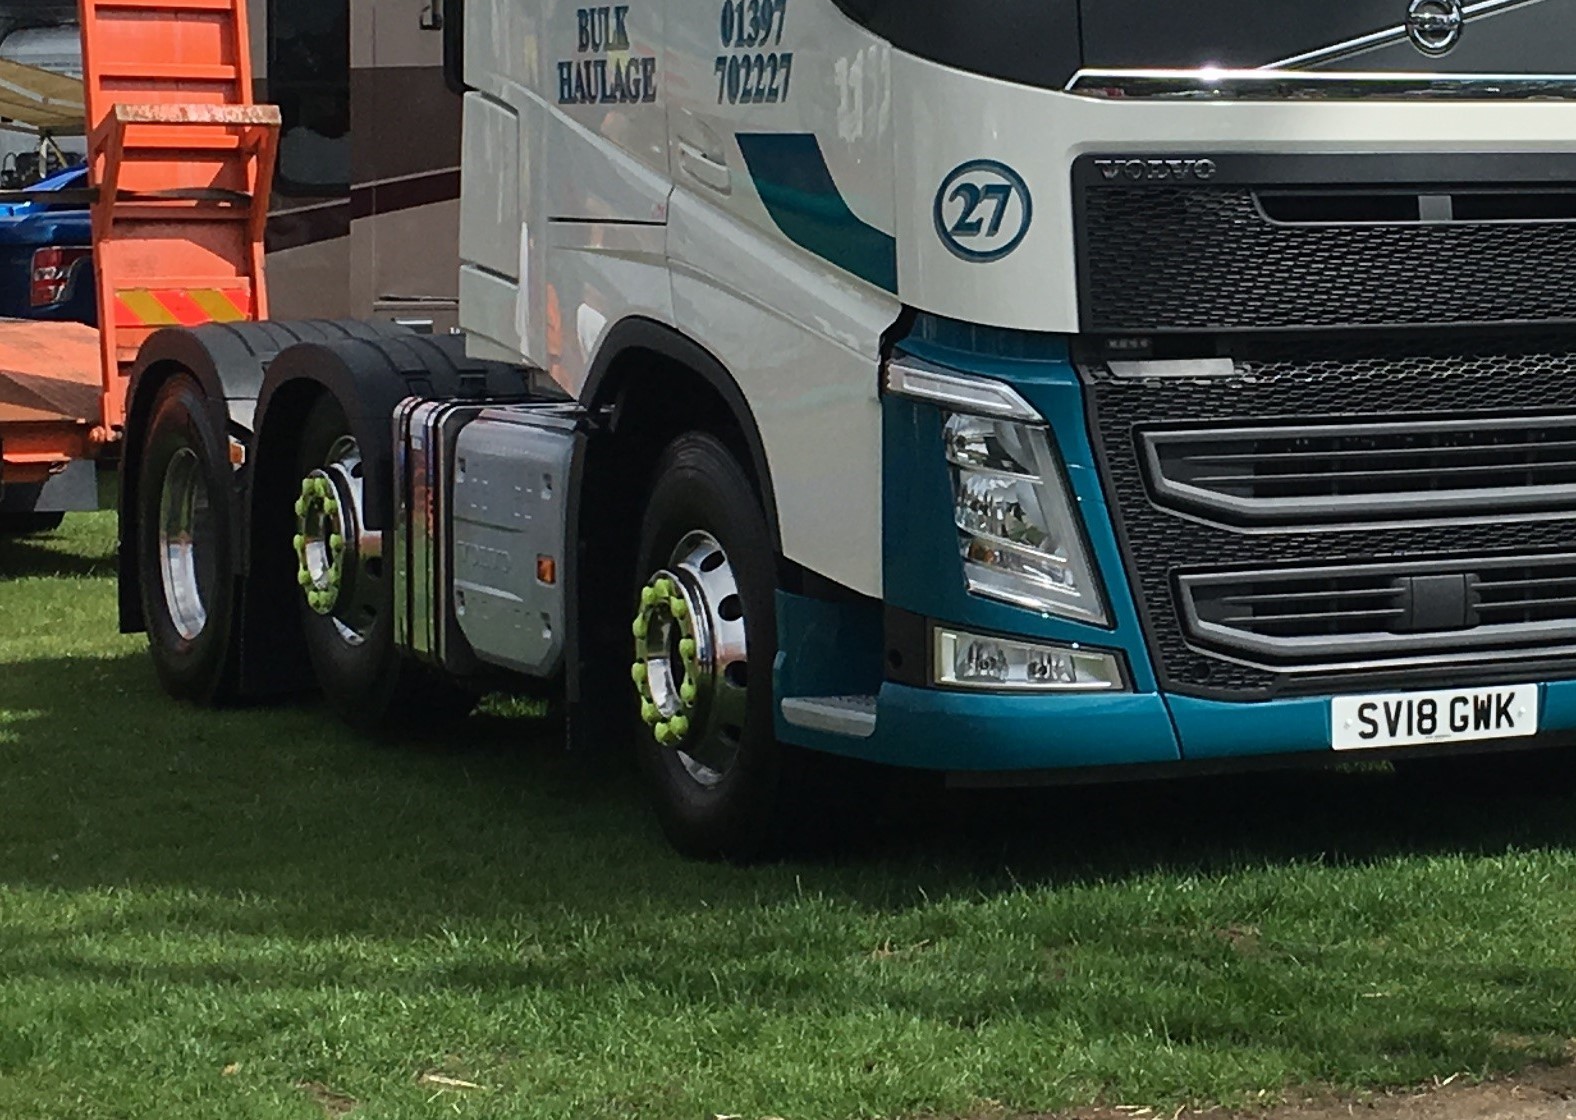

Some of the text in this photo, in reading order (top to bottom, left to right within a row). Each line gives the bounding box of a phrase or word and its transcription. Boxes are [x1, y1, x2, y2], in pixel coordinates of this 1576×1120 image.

[577, 5, 630, 52] BULK
[557, 56, 657, 105] HAULAGE
[713, 52, 794, 105] 702227
[1094, 158, 1217, 179] VOLVO
[948, 182, 1012, 237] 27
[1357, 691, 1516, 740] SV18 GWK
